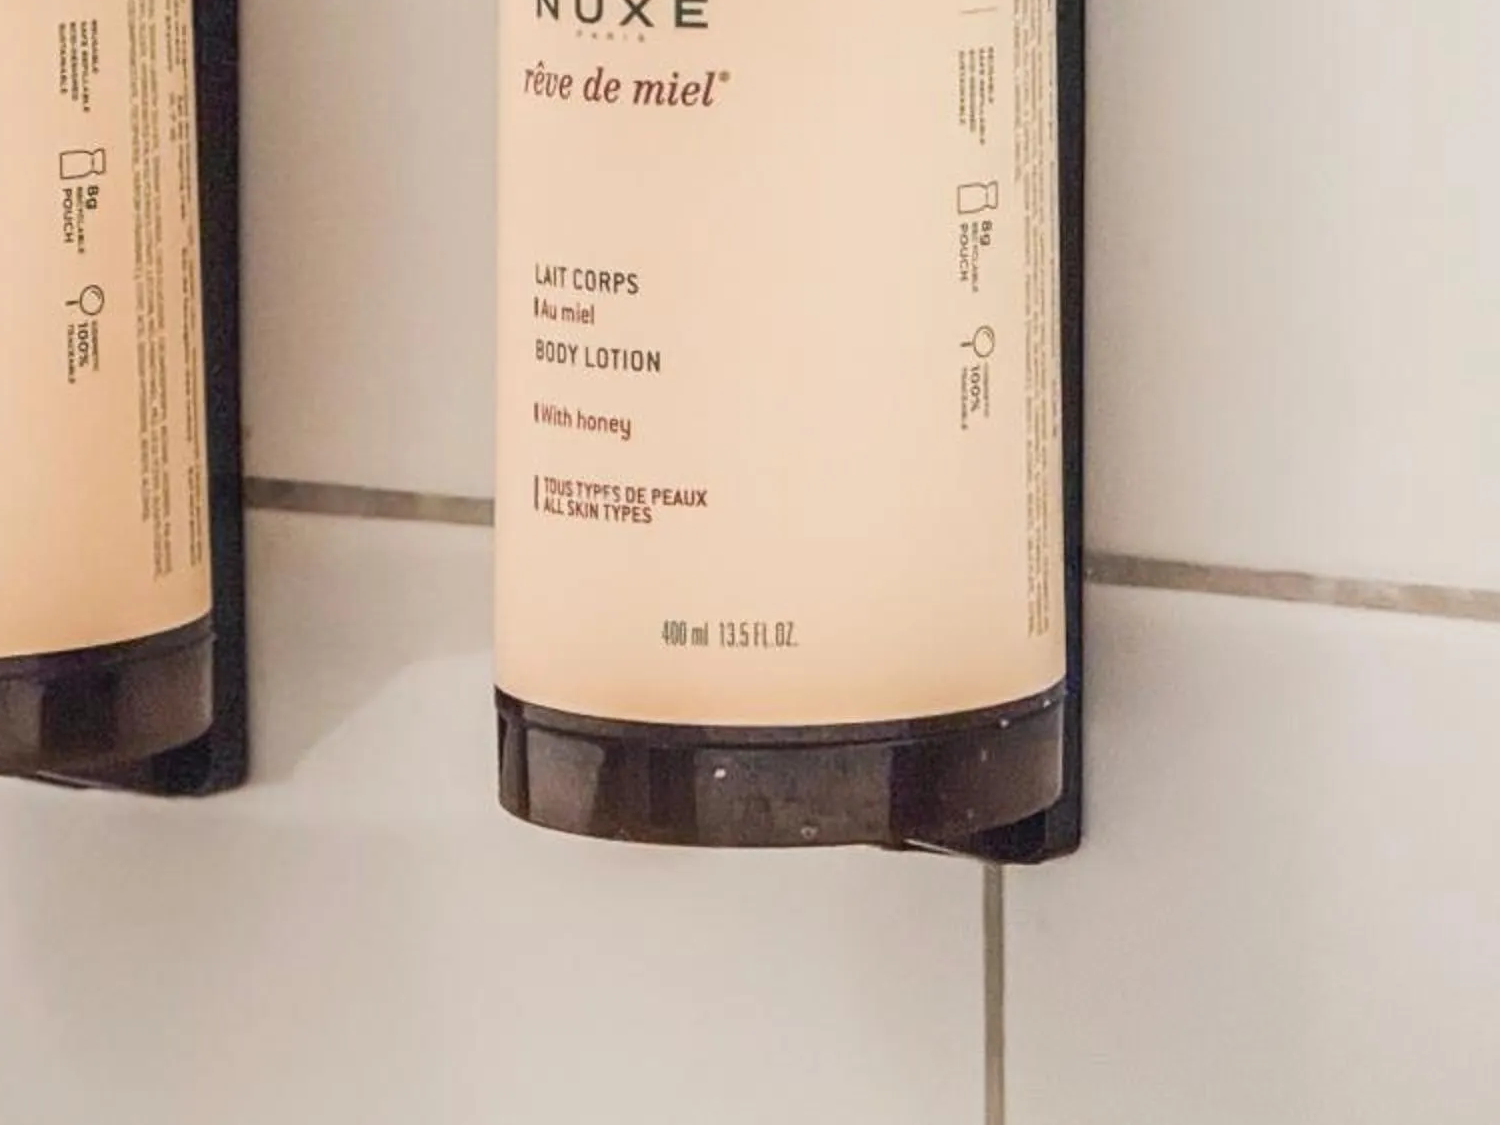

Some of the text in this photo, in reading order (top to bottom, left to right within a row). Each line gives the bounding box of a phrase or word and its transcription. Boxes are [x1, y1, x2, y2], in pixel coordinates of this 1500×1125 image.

[524, 60, 573, 99] rêve
[583, 66, 620, 104] de
[63, 188, 74, 244] POUCH
[959, 222, 969, 282] POUCH
[535, 264, 640, 295] LAIT CORPS
[540, 299, 595, 325] Au miel
[535, 339, 661, 373] BODY LOTION
[541, 402, 632, 441] With honey
[544, 476, 708, 507] TOUS TYPES DE PEAUX
[544, 496, 653, 524] ALL SKIN TYPES
[661, 620, 688, 646] 400
[691, 621, 709, 647] ml
[719, 621, 749, 647] 13.5
